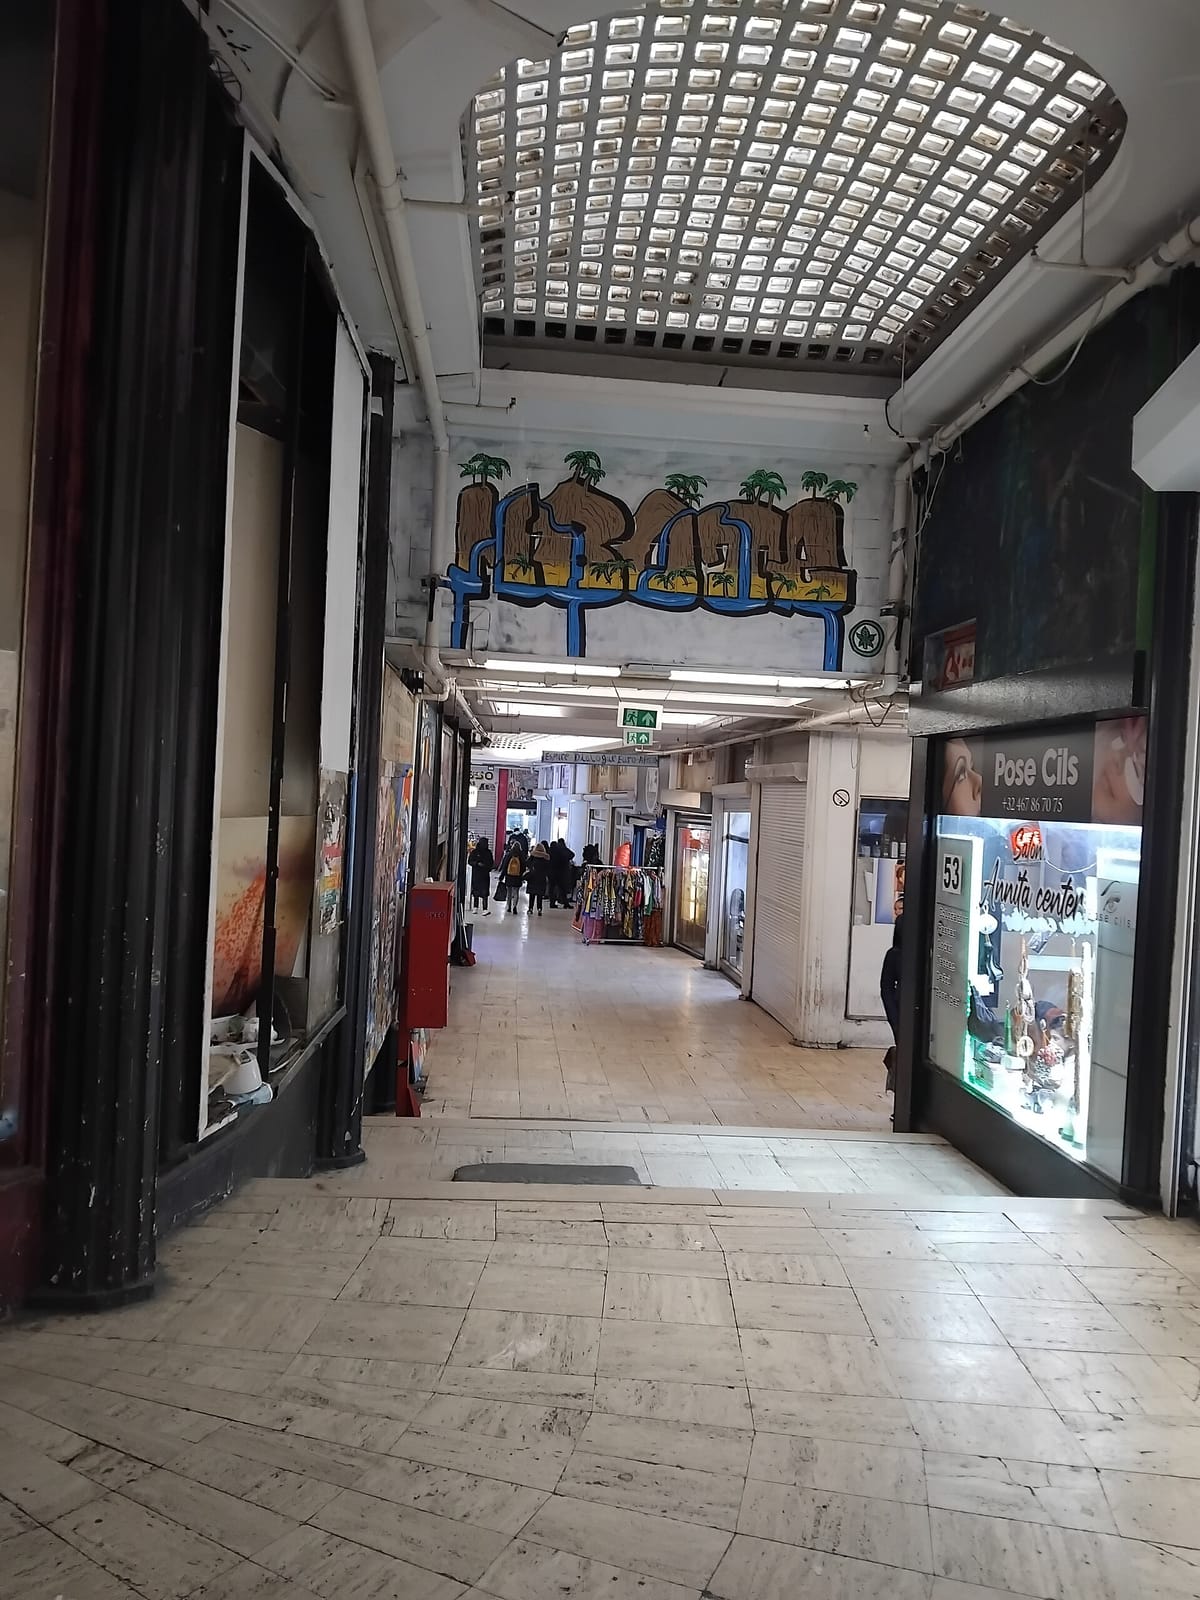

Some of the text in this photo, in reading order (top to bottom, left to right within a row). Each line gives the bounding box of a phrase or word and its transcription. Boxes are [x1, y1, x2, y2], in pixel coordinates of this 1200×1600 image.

[994, 747, 1079, 787] Pose Cils
[1002, 797, 1064, 813] +32 467 86 70 75
[1013, 828, 1046, 861] Salon
[943, 857, 960, 890] 53
[979, 857, 1084, 924] Annita center
